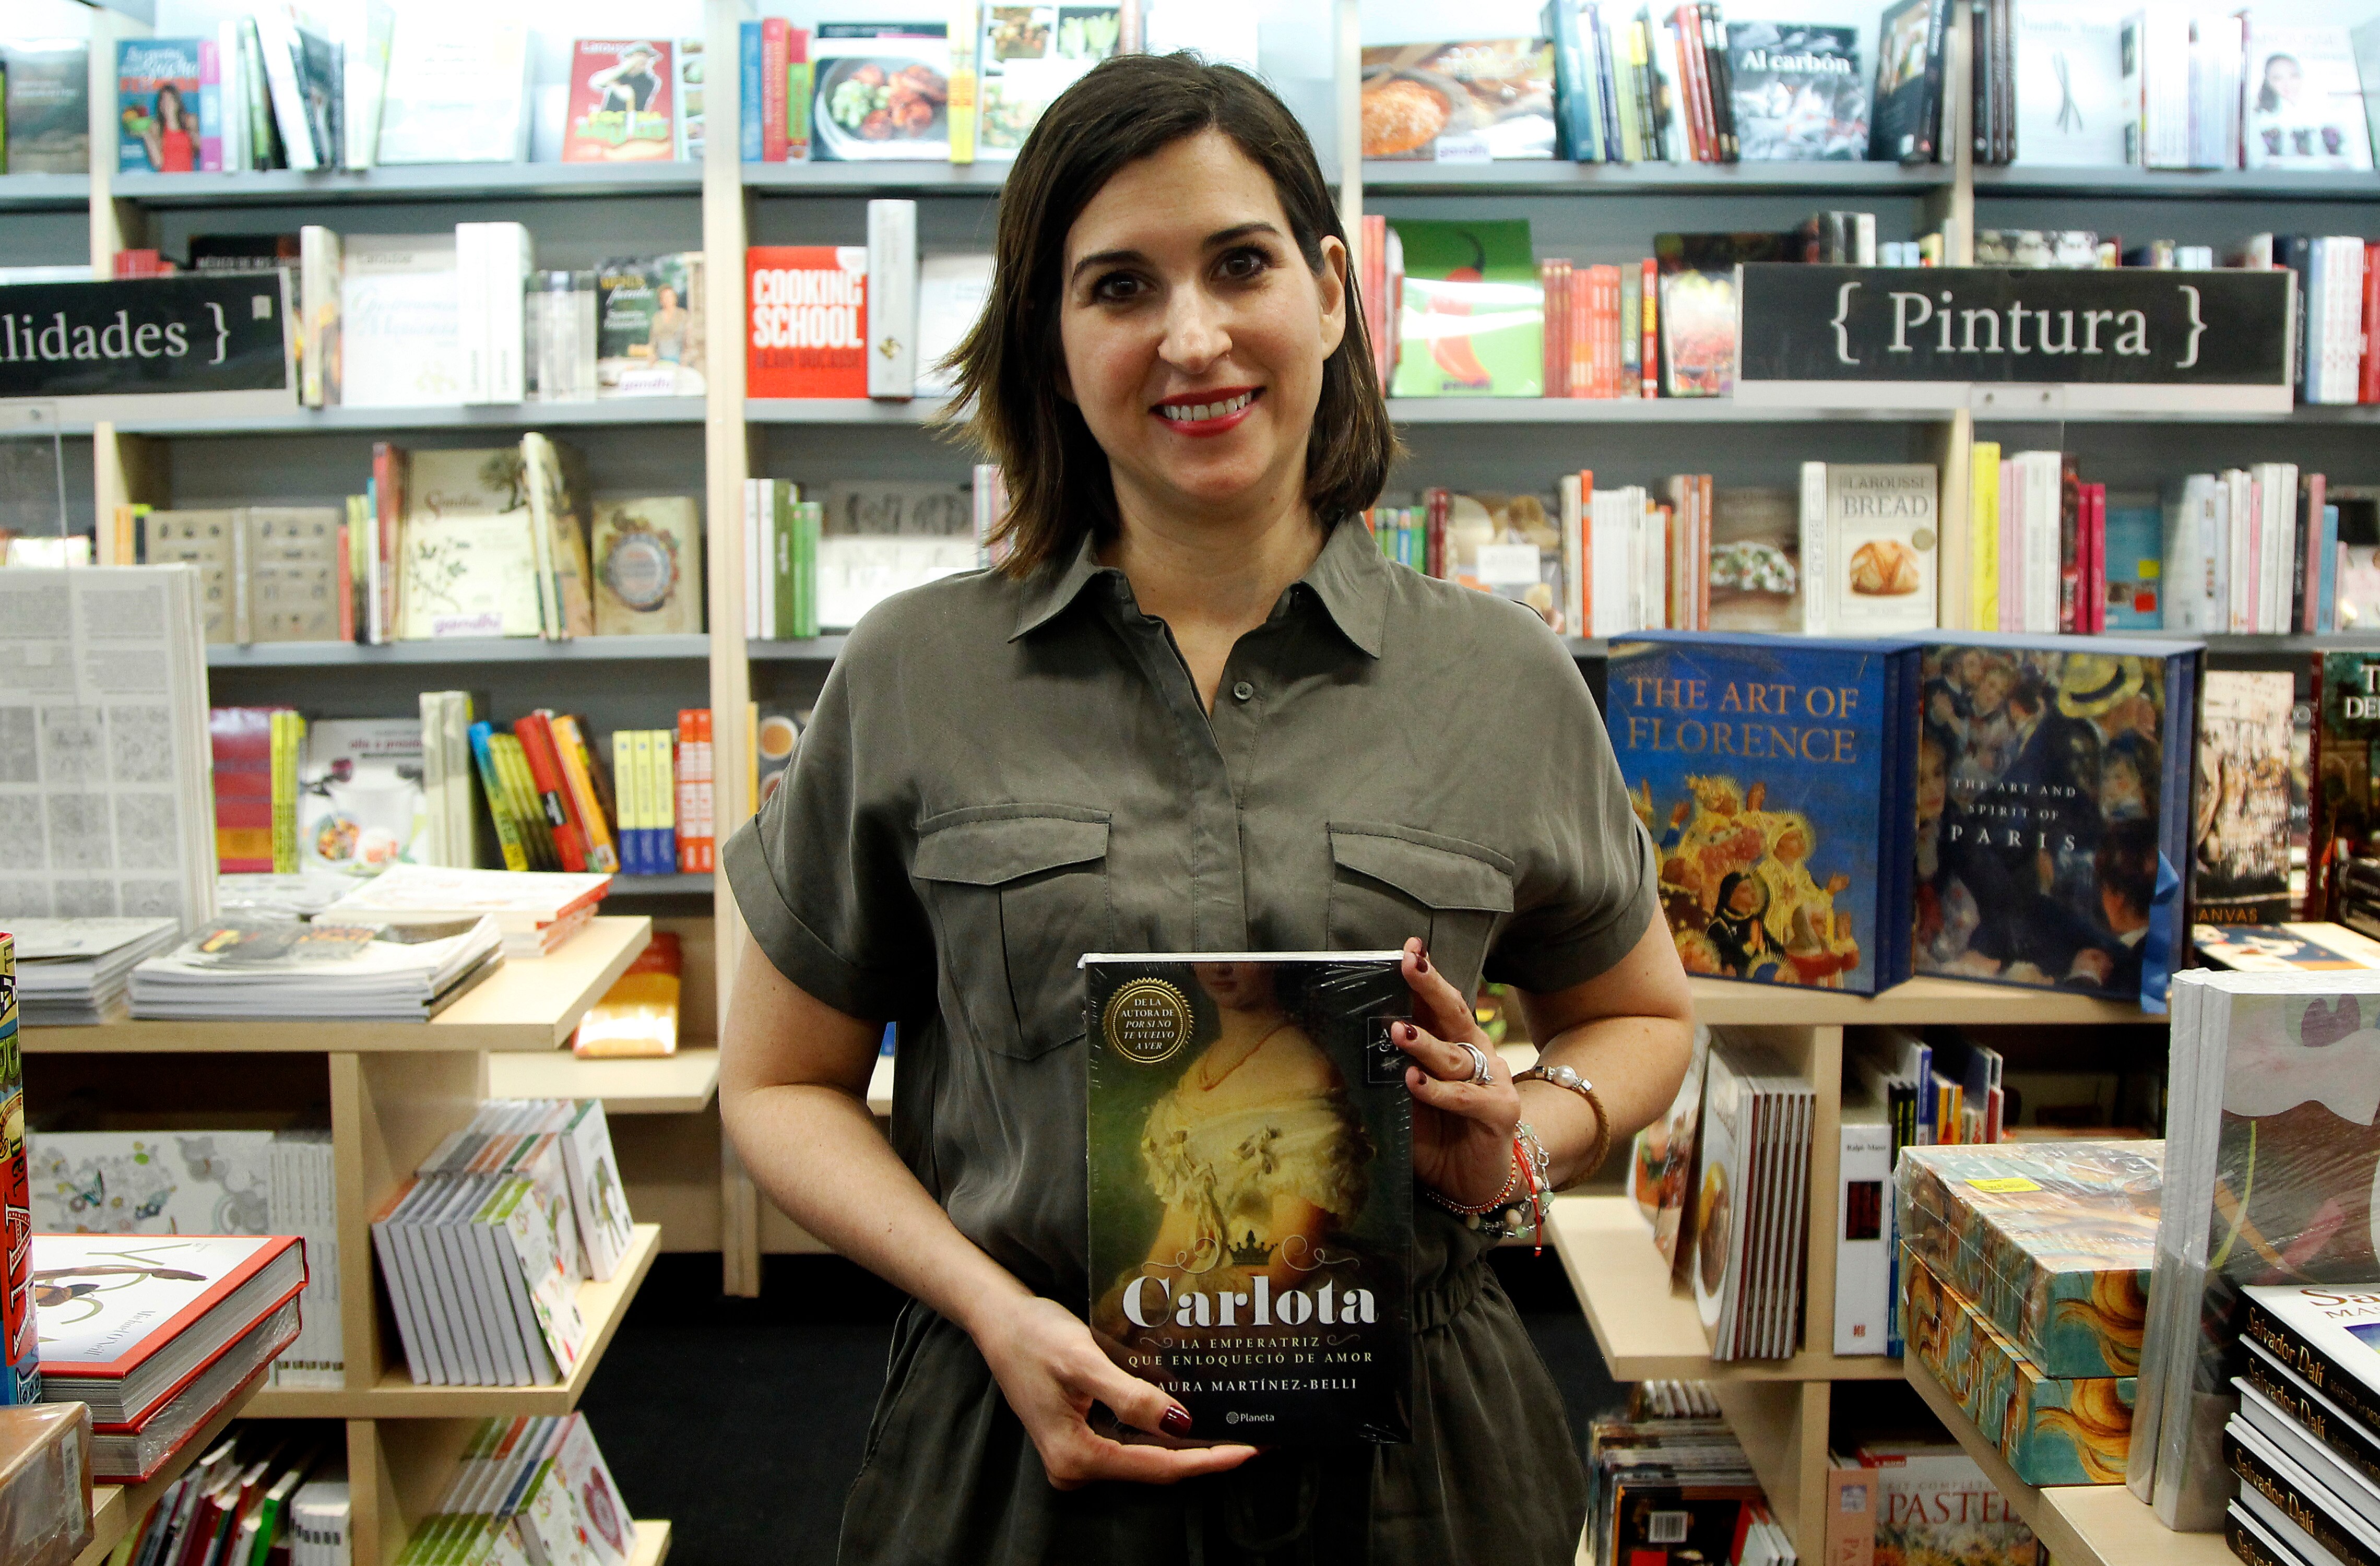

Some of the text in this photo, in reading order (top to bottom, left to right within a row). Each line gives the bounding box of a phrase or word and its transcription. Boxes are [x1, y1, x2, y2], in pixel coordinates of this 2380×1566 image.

[1740, 49, 1851, 75] Al carbón
[753, 268, 863, 306] COOKING
[0, 309, 190, 362] lidades
[753, 305, 863, 349] SCHOOL
[1888, 290, 2151, 355] Pintura
[1848, 476, 1928, 490] LAROUSSE
[1843, 494, 1929, 518] BREAD
[1626, 677, 1860, 718] THE ART OF
[1628, 716, 1857, 764] FLORENCE
[1953, 778, 2076, 798] THE ART AND
[1968, 804, 2059, 821] SPIRIT OF
[1951, 824, 2076, 851] PARIS
[2198, 908, 2257, 923] ANVAS
[1122, 1275, 1379, 1328] Carlota
[1181, 1337, 1320, 1349] LA EMPERATRIZ
[2246, 1307, 2295, 1364] Salvador
[2297, 1345, 2325, 1388] Dalí
[1128, 1352, 1372, 1368] QUE ENLOQUECIÓ DE AMOR
[1158, 1378, 1357, 1392] AURA MARTÍNEZ-BELLI
[2247, 1357, 2297, 1416] Salvador
[2300, 1397, 2326, 1441] Dalí
[1240, 1413, 1275, 1422] Planeta
[2235, 1448, 2285, 1509] Salvador
[2288, 1491, 2315, 1536] Dalí
[1888, 1491, 2018, 1525] PASTEL
